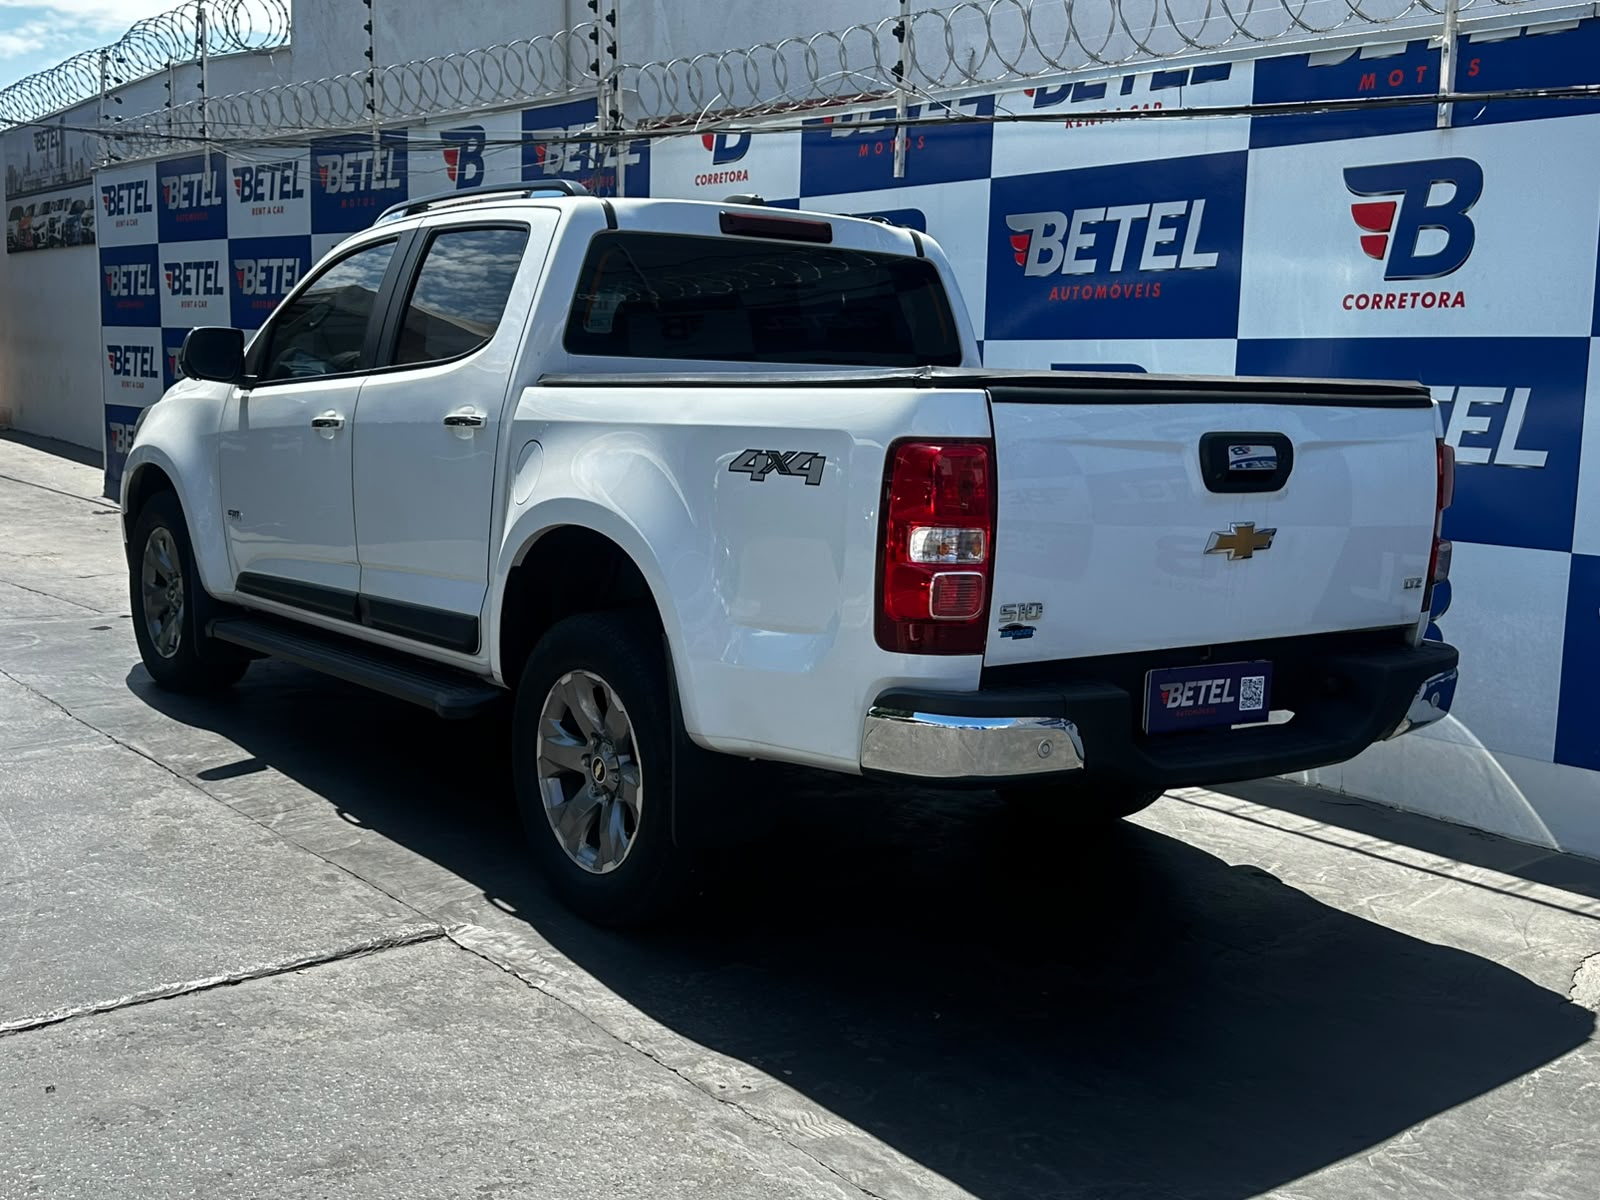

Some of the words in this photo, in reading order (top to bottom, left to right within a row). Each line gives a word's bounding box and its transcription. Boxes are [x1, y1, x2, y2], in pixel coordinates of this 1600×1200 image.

[1358, 58, 1480, 91] MOTS
[232, 161, 304, 203] BETEL
[316, 149, 400, 194] BETEL
[694, 169, 749, 186] CORRETORA
[101, 180, 153, 217] BETEL
[161, 170, 222, 210] BETEL
[252, 207, 266, 216] RENT
[273, 205, 284, 215] CAR
[1343, 156, 1483, 281] B
[1005, 199, 1219, 277] BETEL
[104, 263, 155, 296] BETEL
[164, 260, 224, 296] BETEL
[1049, 281, 1162, 302] AUTOMÓVEIS
[1342, 291, 1466, 310] CORRETORA
[107, 344, 158, 378] BETEL
[1403, 577, 1423, 590] LTZ
[998, 602, 1043, 623] S10
[1159, 678, 1235, 709] BETEL
